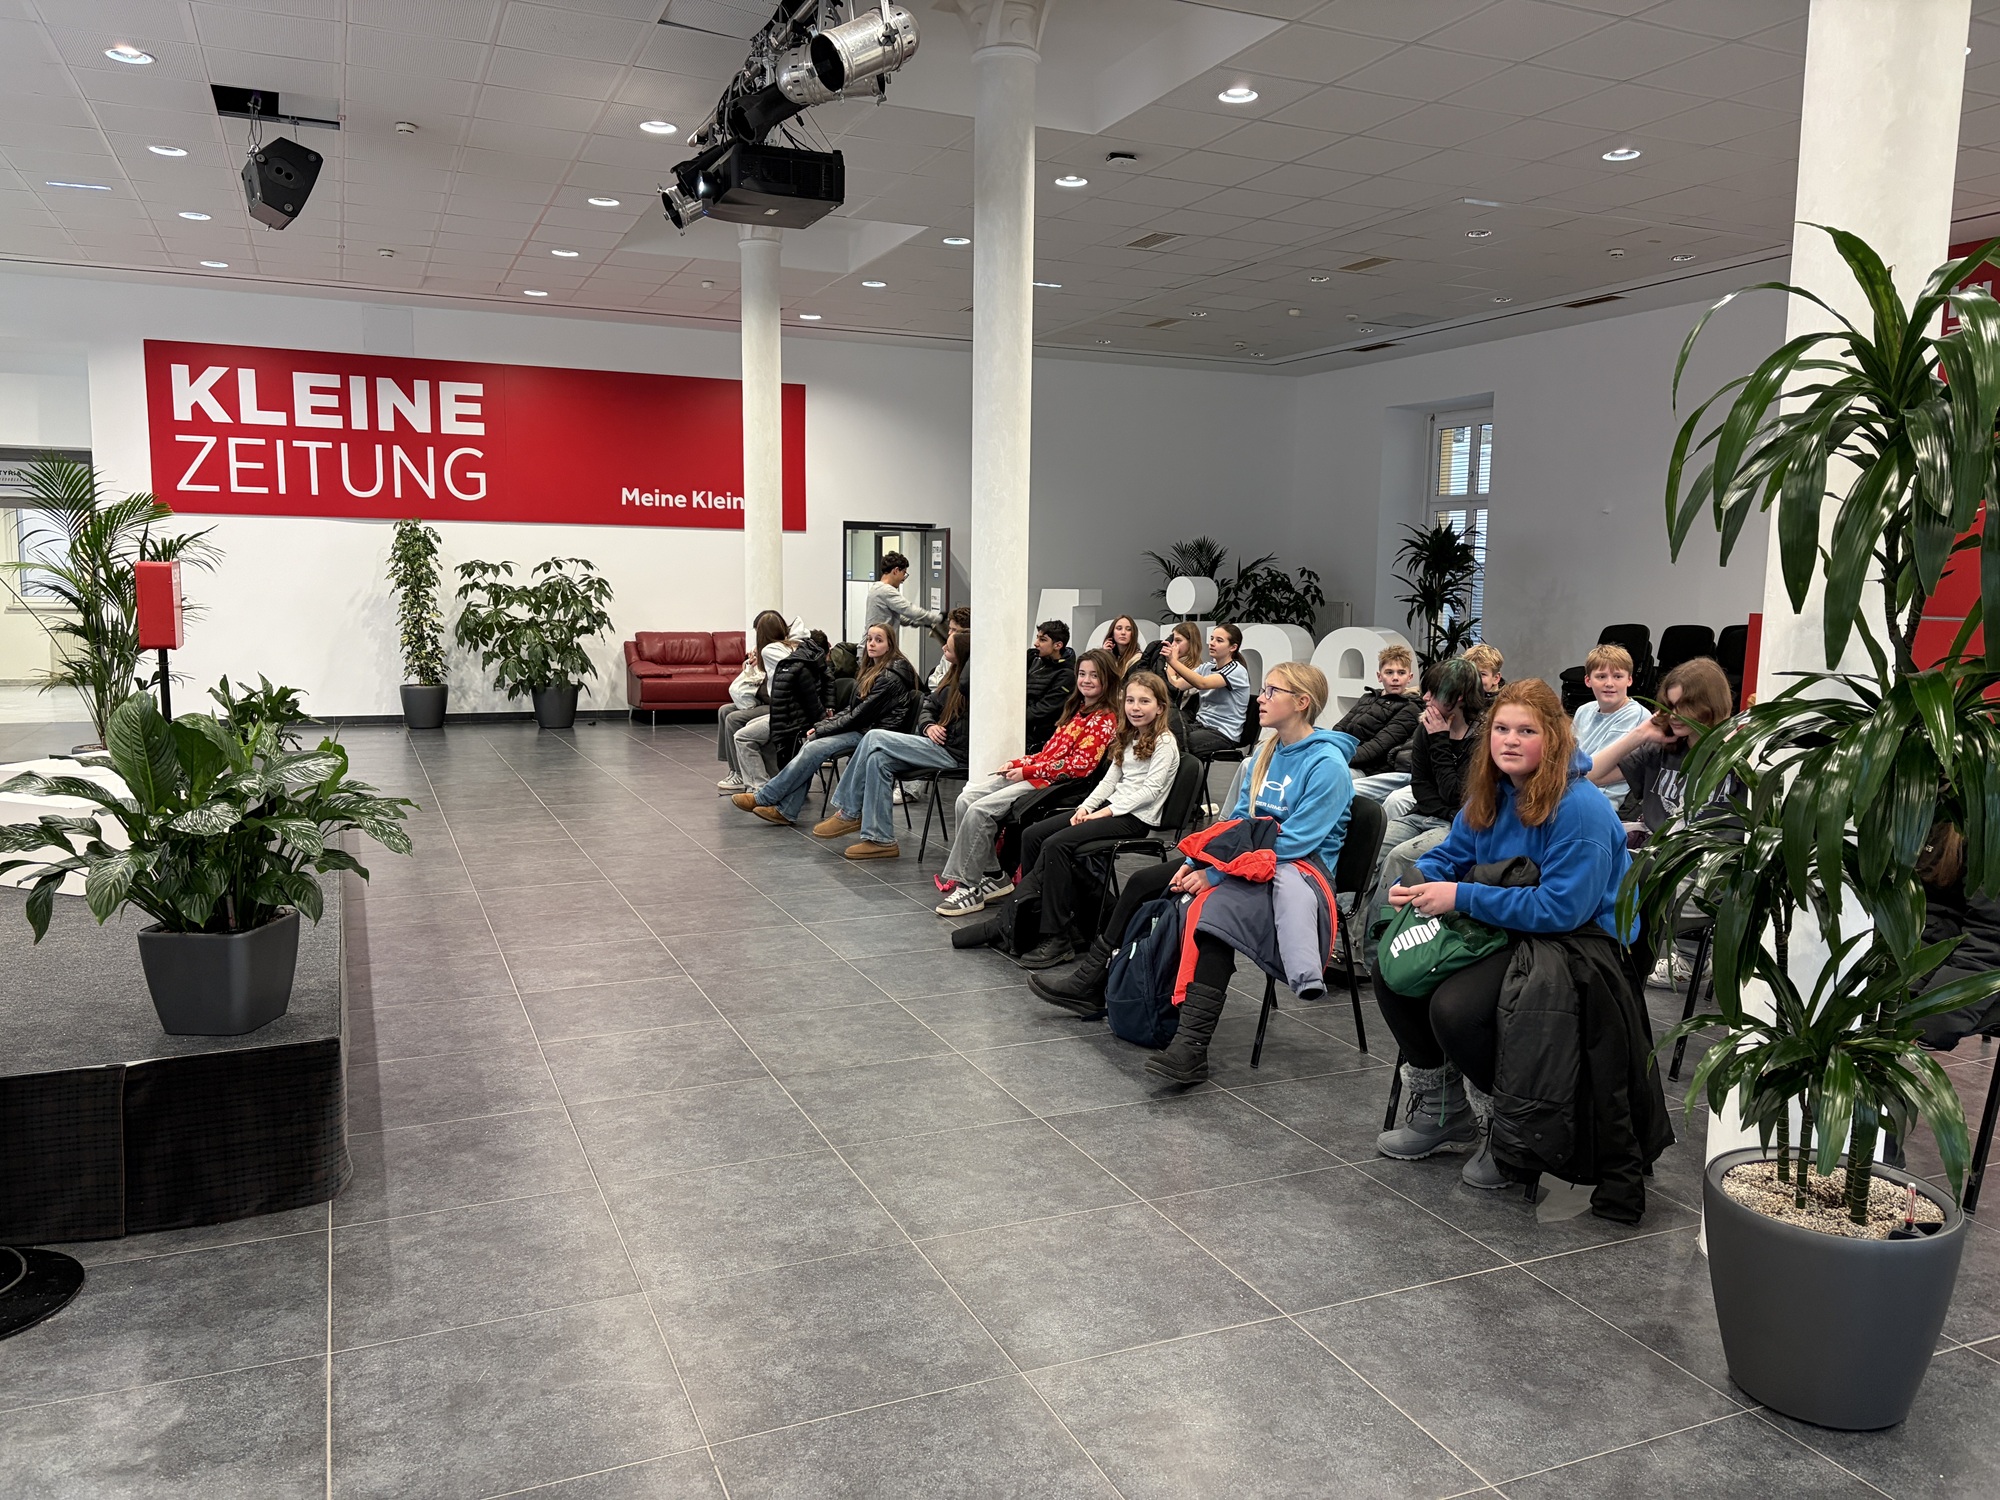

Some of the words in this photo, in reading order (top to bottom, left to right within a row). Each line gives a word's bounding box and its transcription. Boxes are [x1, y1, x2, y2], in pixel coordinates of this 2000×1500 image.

[171, 364, 485, 436] KLEINE
[175, 435, 486, 501] ZEITUNG
[621, 487, 687, 508] Meine
[1389, 917, 1441, 959] PUMA
